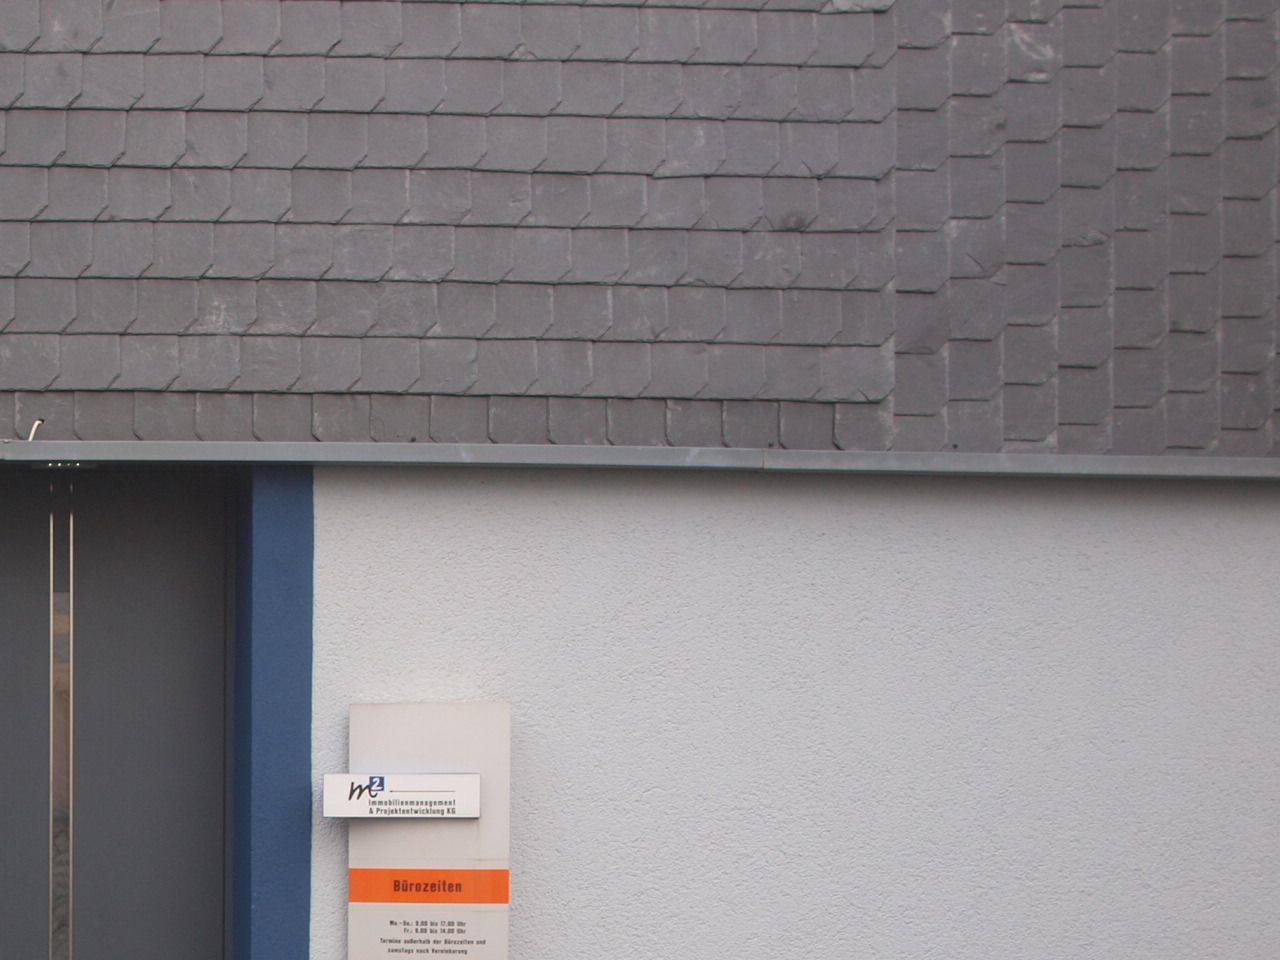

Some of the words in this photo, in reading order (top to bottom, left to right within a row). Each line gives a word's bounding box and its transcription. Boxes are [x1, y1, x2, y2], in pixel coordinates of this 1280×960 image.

[368, 799, 456, 807] Immobilienmanagement
[376, 807, 445, 816] Projektentwicklung
[393, 880, 462, 893] Bürozeiten
